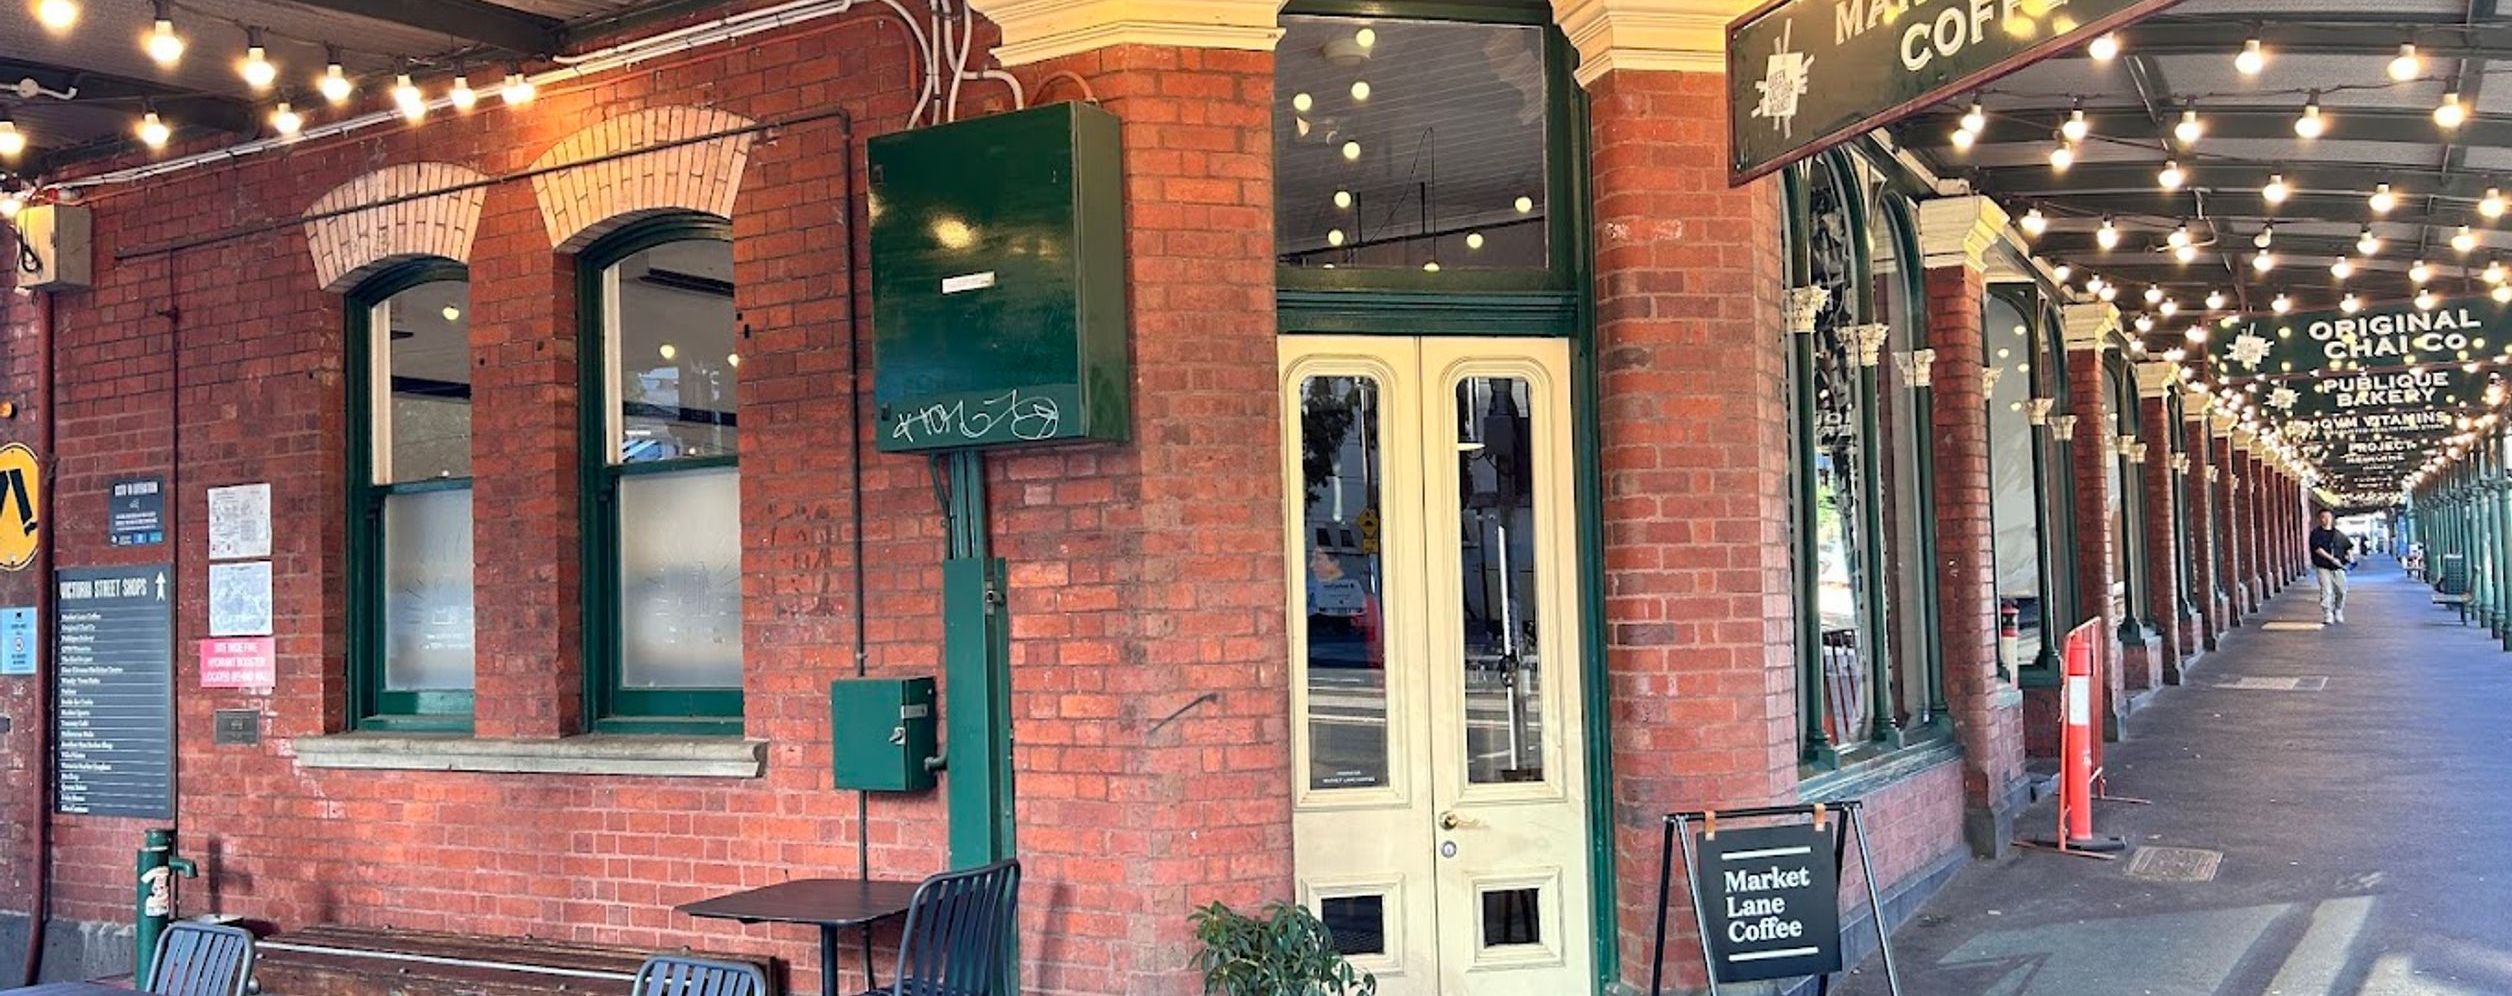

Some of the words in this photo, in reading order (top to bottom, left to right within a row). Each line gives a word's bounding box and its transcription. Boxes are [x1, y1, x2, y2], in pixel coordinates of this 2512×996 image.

[2308, 309, 2482, 341] ORIGINAL
[2323, 335, 2409, 359] CHAI
[2420, 333, 2467, 351] CO
[2323, 371, 2449, 394] PUBLIQUE
[2336, 387, 2437, 407] BAKERY
[2363, 411, 2446, 428] VITAMINS
[2348, 440, 2413, 453] PROJECT
[60, 581, 93, 600] VICTORIA
[94, 579, 121, 599] STREET
[121, 577, 147, 597] SHOPS
[1724, 866, 1811, 893] Market
[1726, 896, 1786, 918] Lane
[1728, 916, 1803, 943] Coffee
